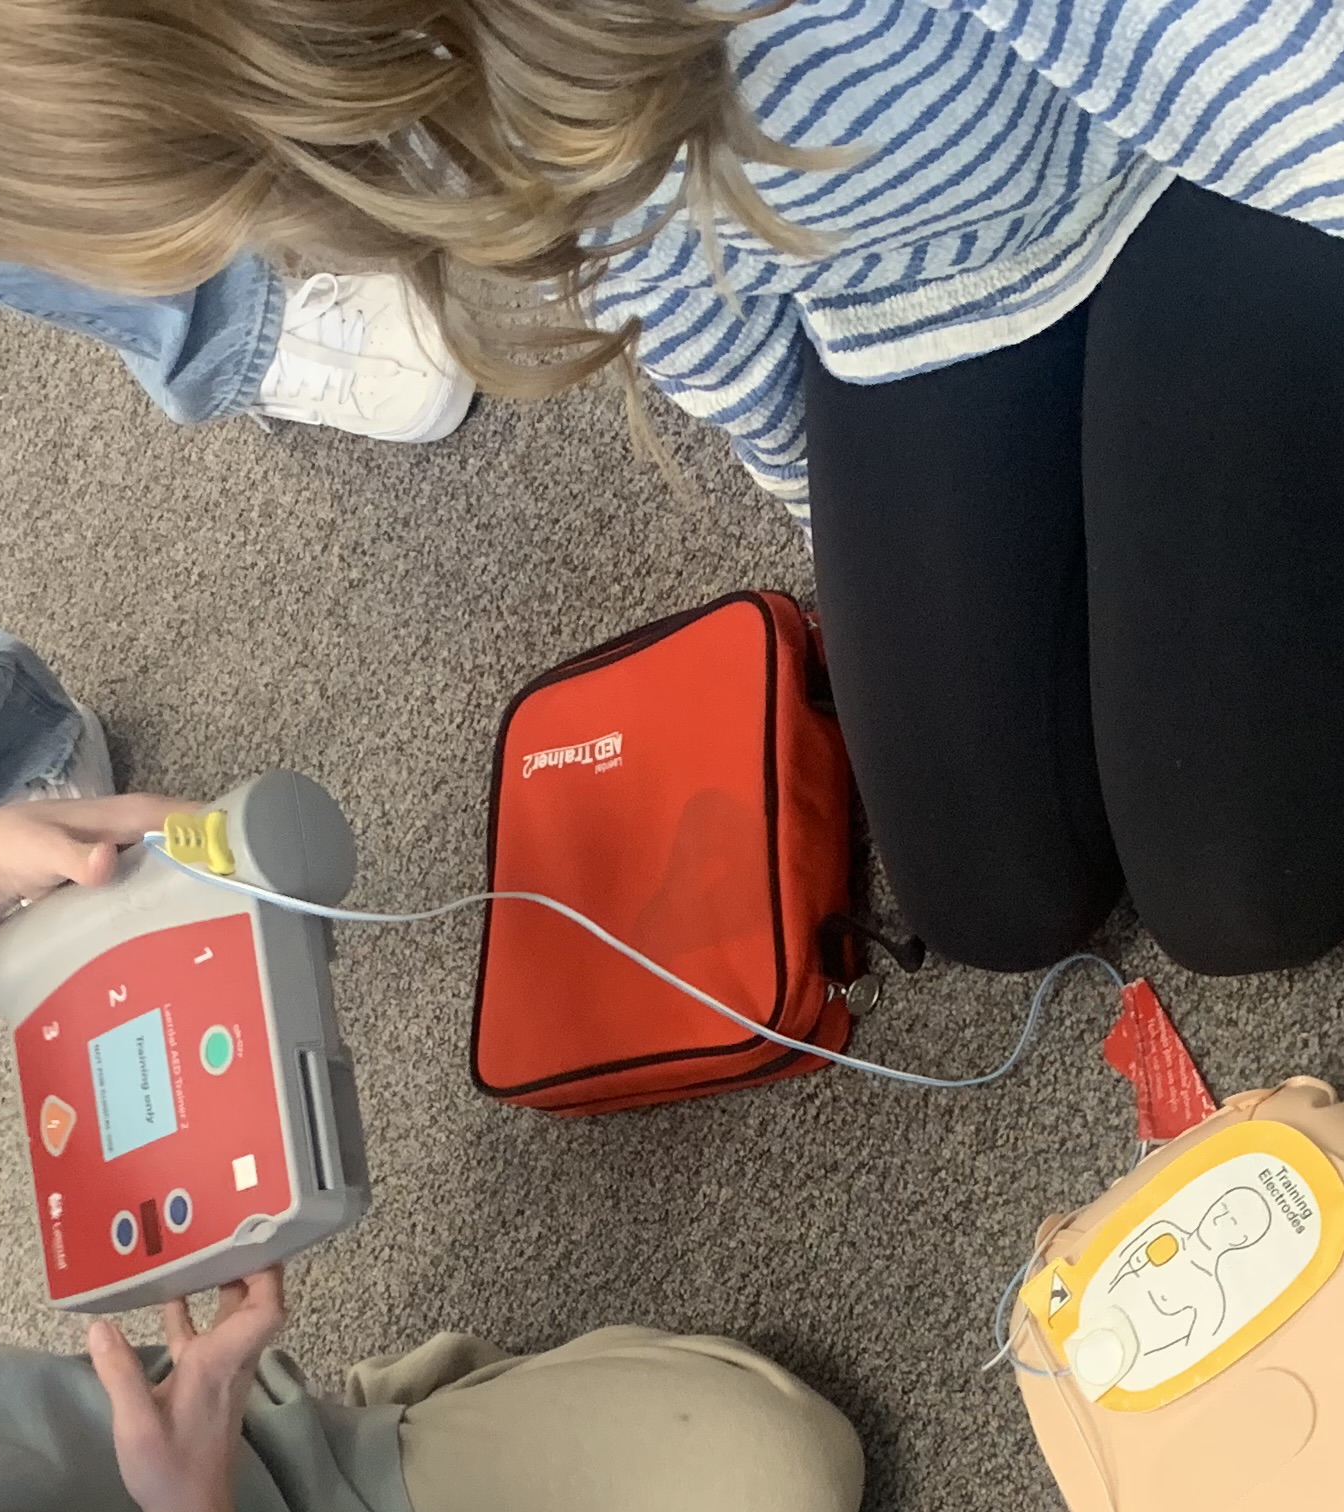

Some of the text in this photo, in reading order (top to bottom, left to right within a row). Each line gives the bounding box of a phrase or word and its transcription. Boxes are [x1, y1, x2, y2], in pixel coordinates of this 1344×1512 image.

[594, 733, 623, 761] AED
[193, 946, 214, 965] 1
[108, 984, 128, 1008] 2
[42, 1021, 61, 1041] 3
[171, 1050, 182, 1075] AED
[136, 1035, 155, 1124] Training only
[174, 1074, 187, 1119] Trainer
[1258, 1168, 1306, 1235] Electrodes
[1275, 1165, 1313, 1220] Training
